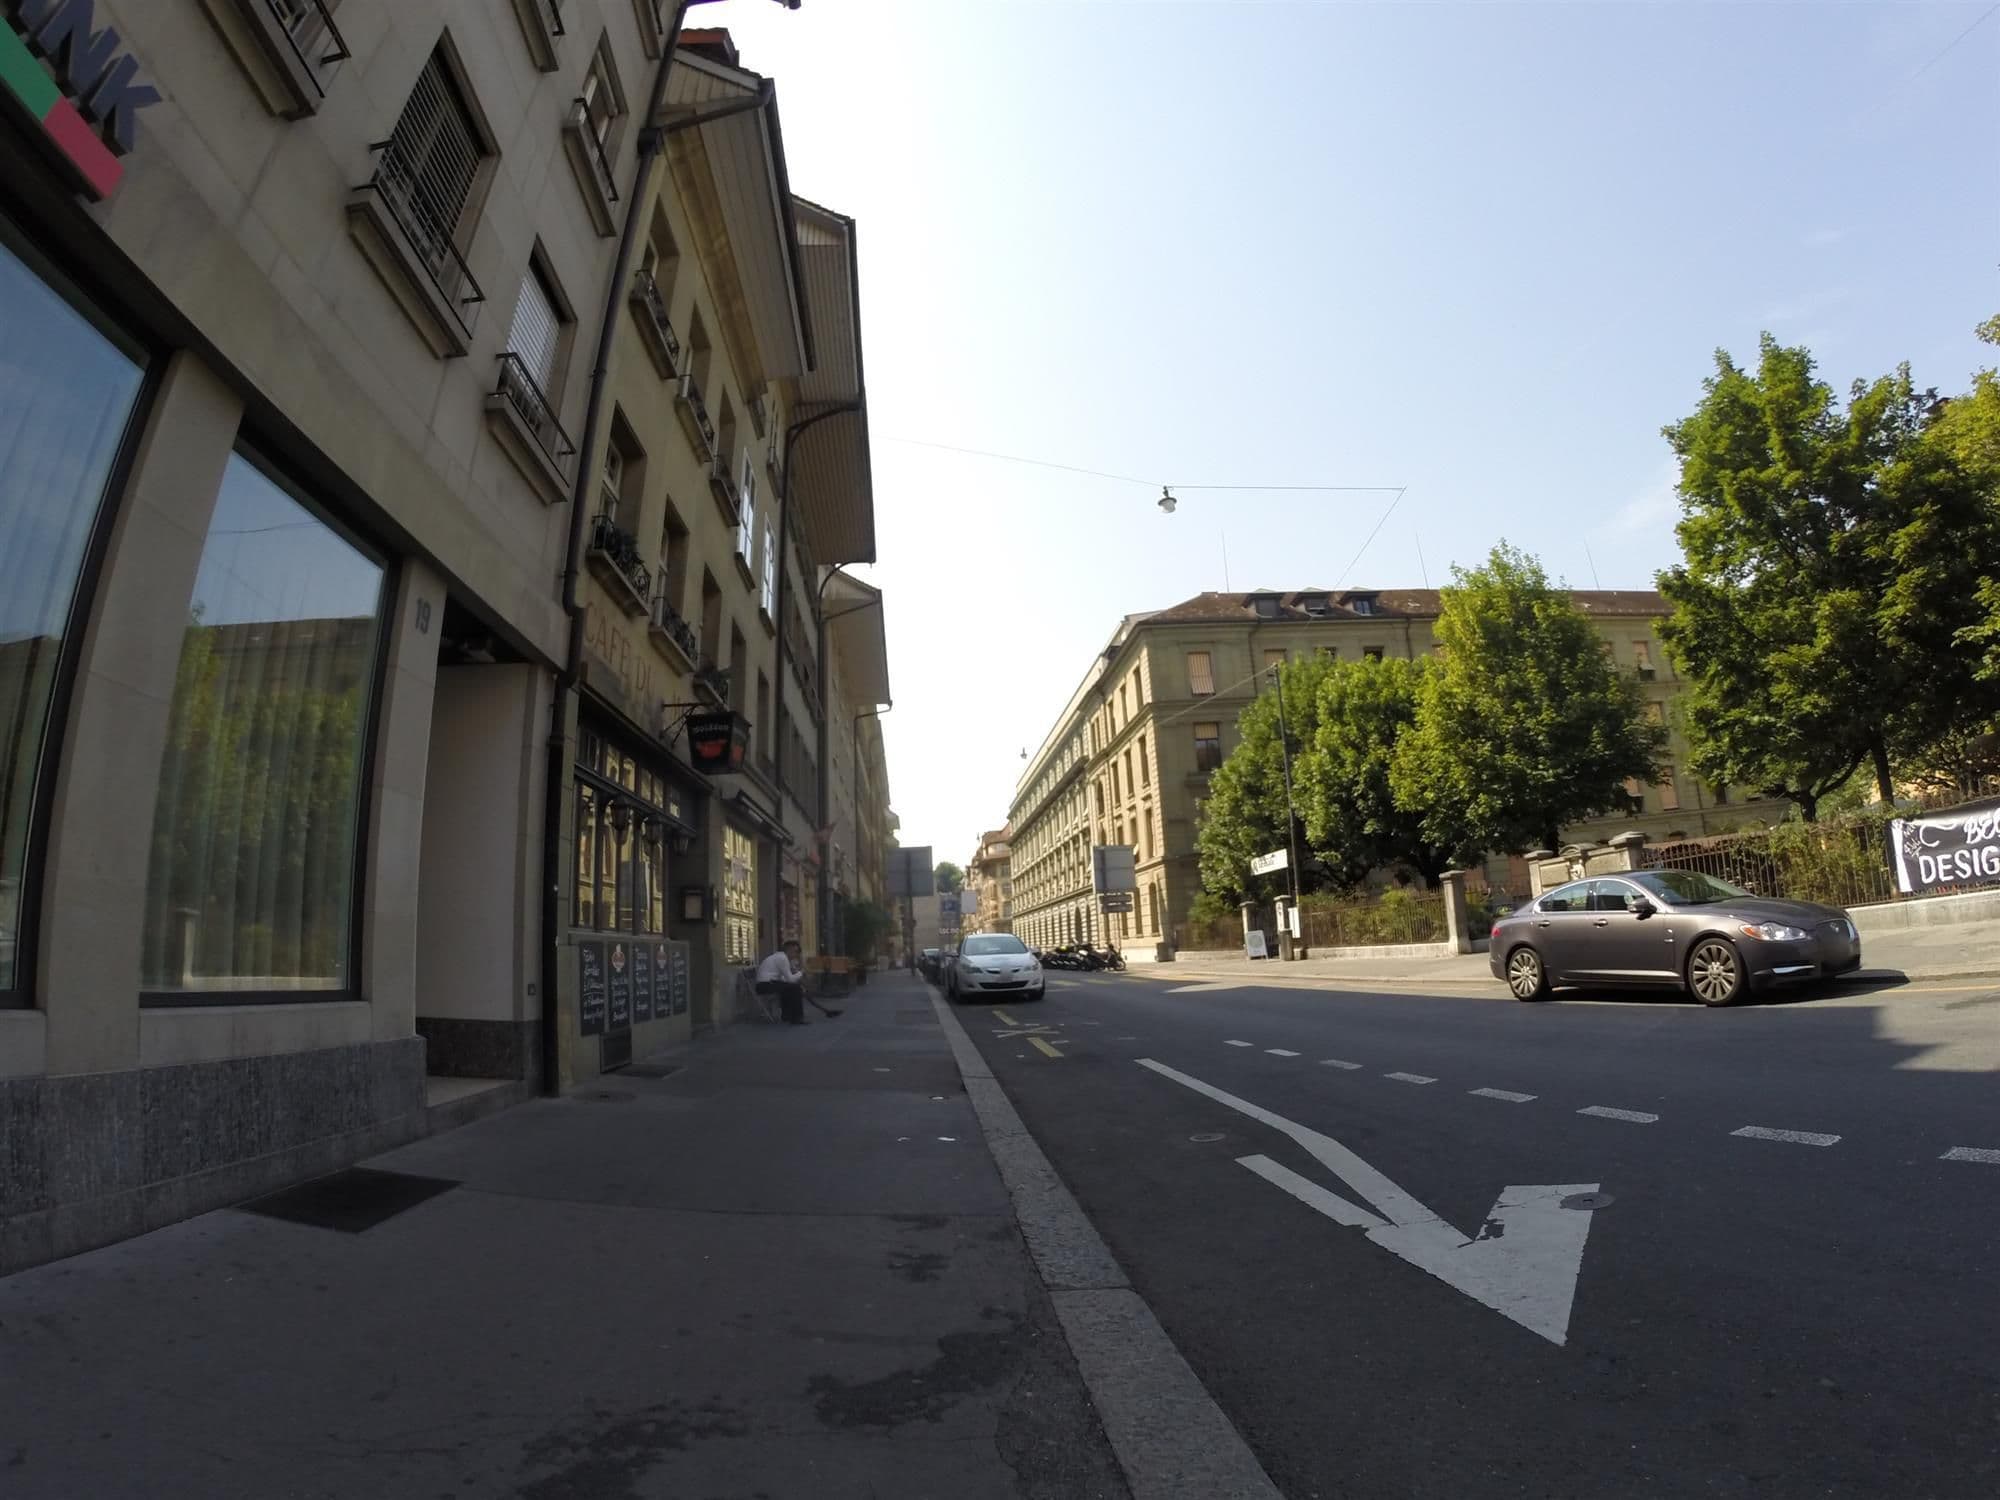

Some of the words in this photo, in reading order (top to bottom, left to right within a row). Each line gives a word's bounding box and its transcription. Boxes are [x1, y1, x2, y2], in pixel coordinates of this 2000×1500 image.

[19, 0, 163, 153] NK
[415, 597, 432, 634] 19
[1918, 845, 2000, 884] DESIG
